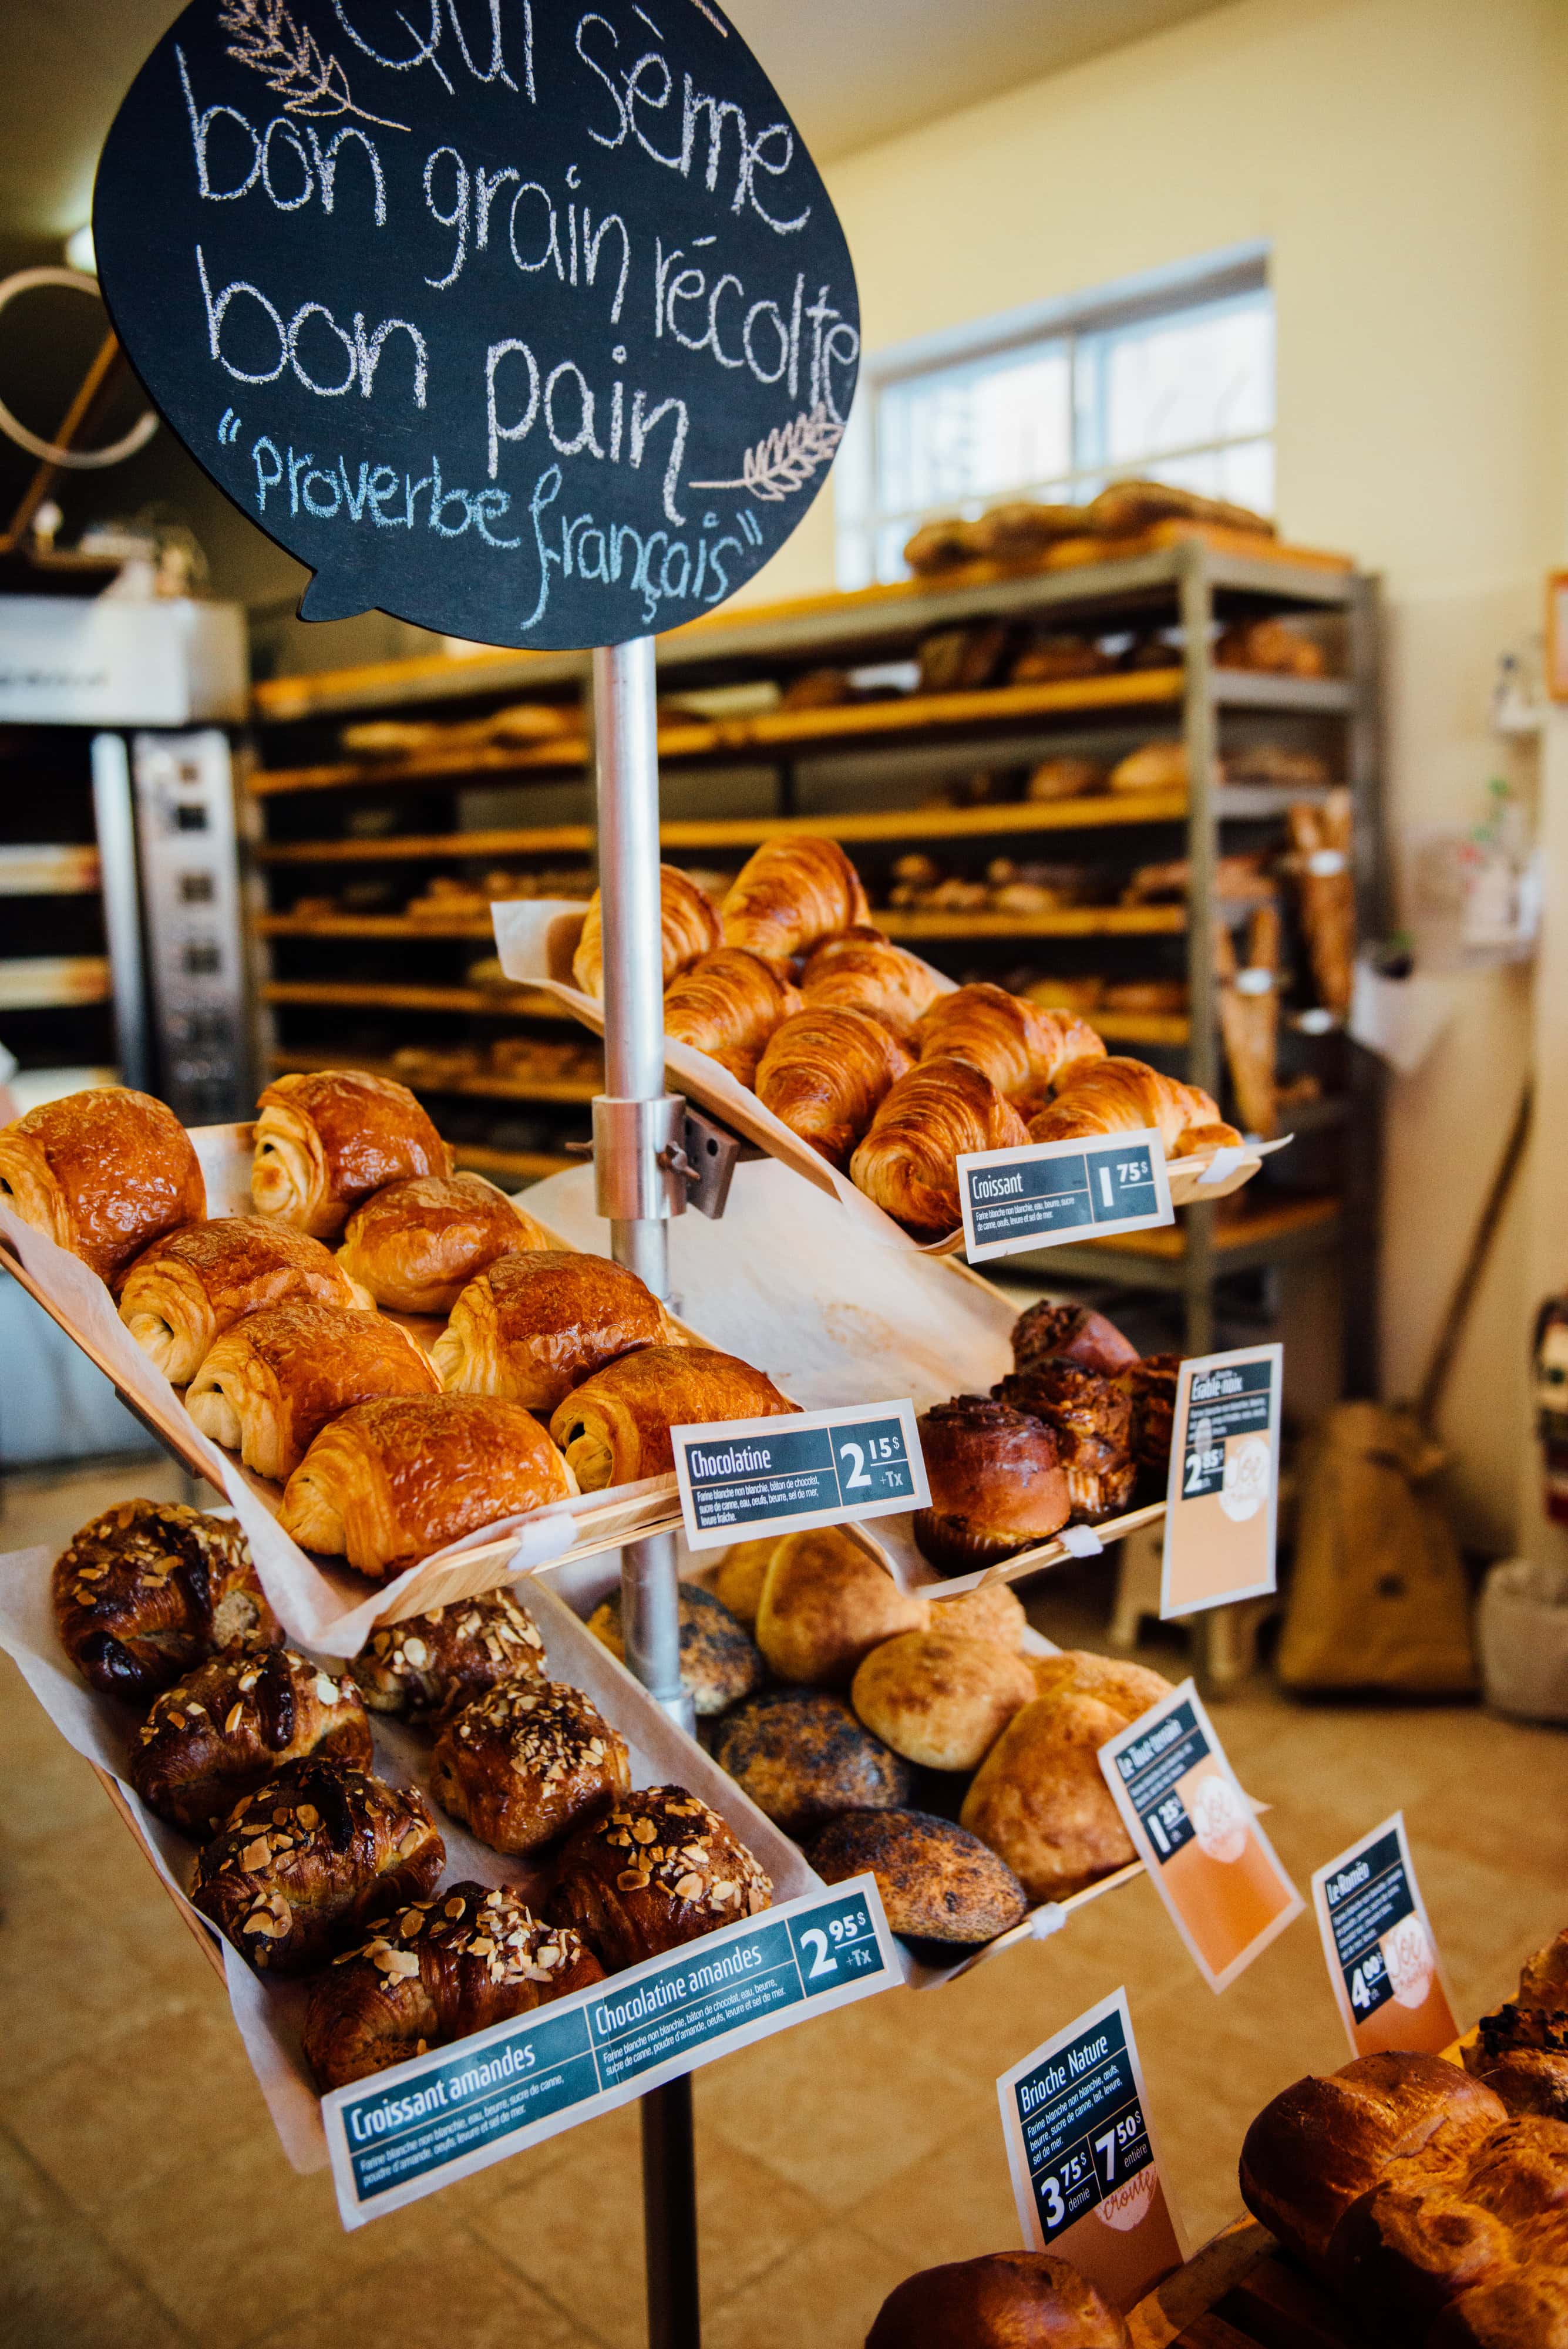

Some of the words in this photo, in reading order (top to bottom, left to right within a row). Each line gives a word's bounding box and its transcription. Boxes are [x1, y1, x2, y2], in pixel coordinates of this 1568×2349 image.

[174, 43, 386, 227] bon
[423, 146, 631, 324] grain
[654, 236, 861, 424] récolte
[196, 245, 428, 409] bon
[486, 338, 689, 526] pain
[973, 1173, 1023, 1199] Croissant
[691, 1448, 771, 1478] Chocolatine
[840, 1443, 872, 1489] 2
[1185, 1454, 1203, 1492] 2
[734, 1488, 745, 1496] non
[786, 1479, 794, 1489] de
[788, 1489, 798, 1500] sel
[797, 1489, 806, 1499] de
[800, 1929, 837, 1978] 2
[595, 1978, 686, 2034] Chocolatine
[689, 1946, 762, 1991] amandes
[1352, 1968, 1371, 2008] 4
[605, 2061, 624, 2076] sucre
[624, 2056, 633, 2067] de
[653, 2036, 675, 2054] poudre
[725, 2004, 745, 2018] levure
[745, 2000, 752, 2010] et
[752, 1995, 762, 2007] sel
[762, 1993, 771, 2003] de
[623, 2036, 647, 2054] blanche
[647, 2030, 659, 2042] non
[659, 2018, 687, 2037] blanchie,
[686, 2009, 704, 2024] bâton
[704, 2005, 713, 2015] de
[713, 1992, 741, 2011] chocolat,
[740, 1988, 755, 2000] eau,
[753, 1979, 778, 1994] beurre,
[352, 2081, 447, 2139] Croissant
[450, 2045, 535, 2099] amandes
[529, 2084, 540, 2096] de
[1021, 2067, 1066, 2112] Brioche
[1068, 2036, 1108, 2077] Nature
[499, 2112, 510, 2123] de
[1027, 2119, 1045, 2138] Farine
[1045, 2102, 1068, 2124] blanche
[1068, 2094, 1079, 2107] non
[1078, 2077, 1103, 2099] blanchie,
[1029, 2132, 1051, 2151] beurre,
[1051, 2118, 1066, 2136] sucre
[1066, 2112, 1075, 2123] de
[1075, 2099, 1093, 2117] canne,
[1033, 2150, 1042, 2165] sel
[1042, 2146, 1050, 2158] de
[1050, 2136, 1064, 2151] mer.
[1095, 2129, 1115, 2180] 7
[1124, 2143, 1148, 2168] entière
[1041, 2177, 1065, 2226] 3
[1068, 2188, 1090, 2212] demie
